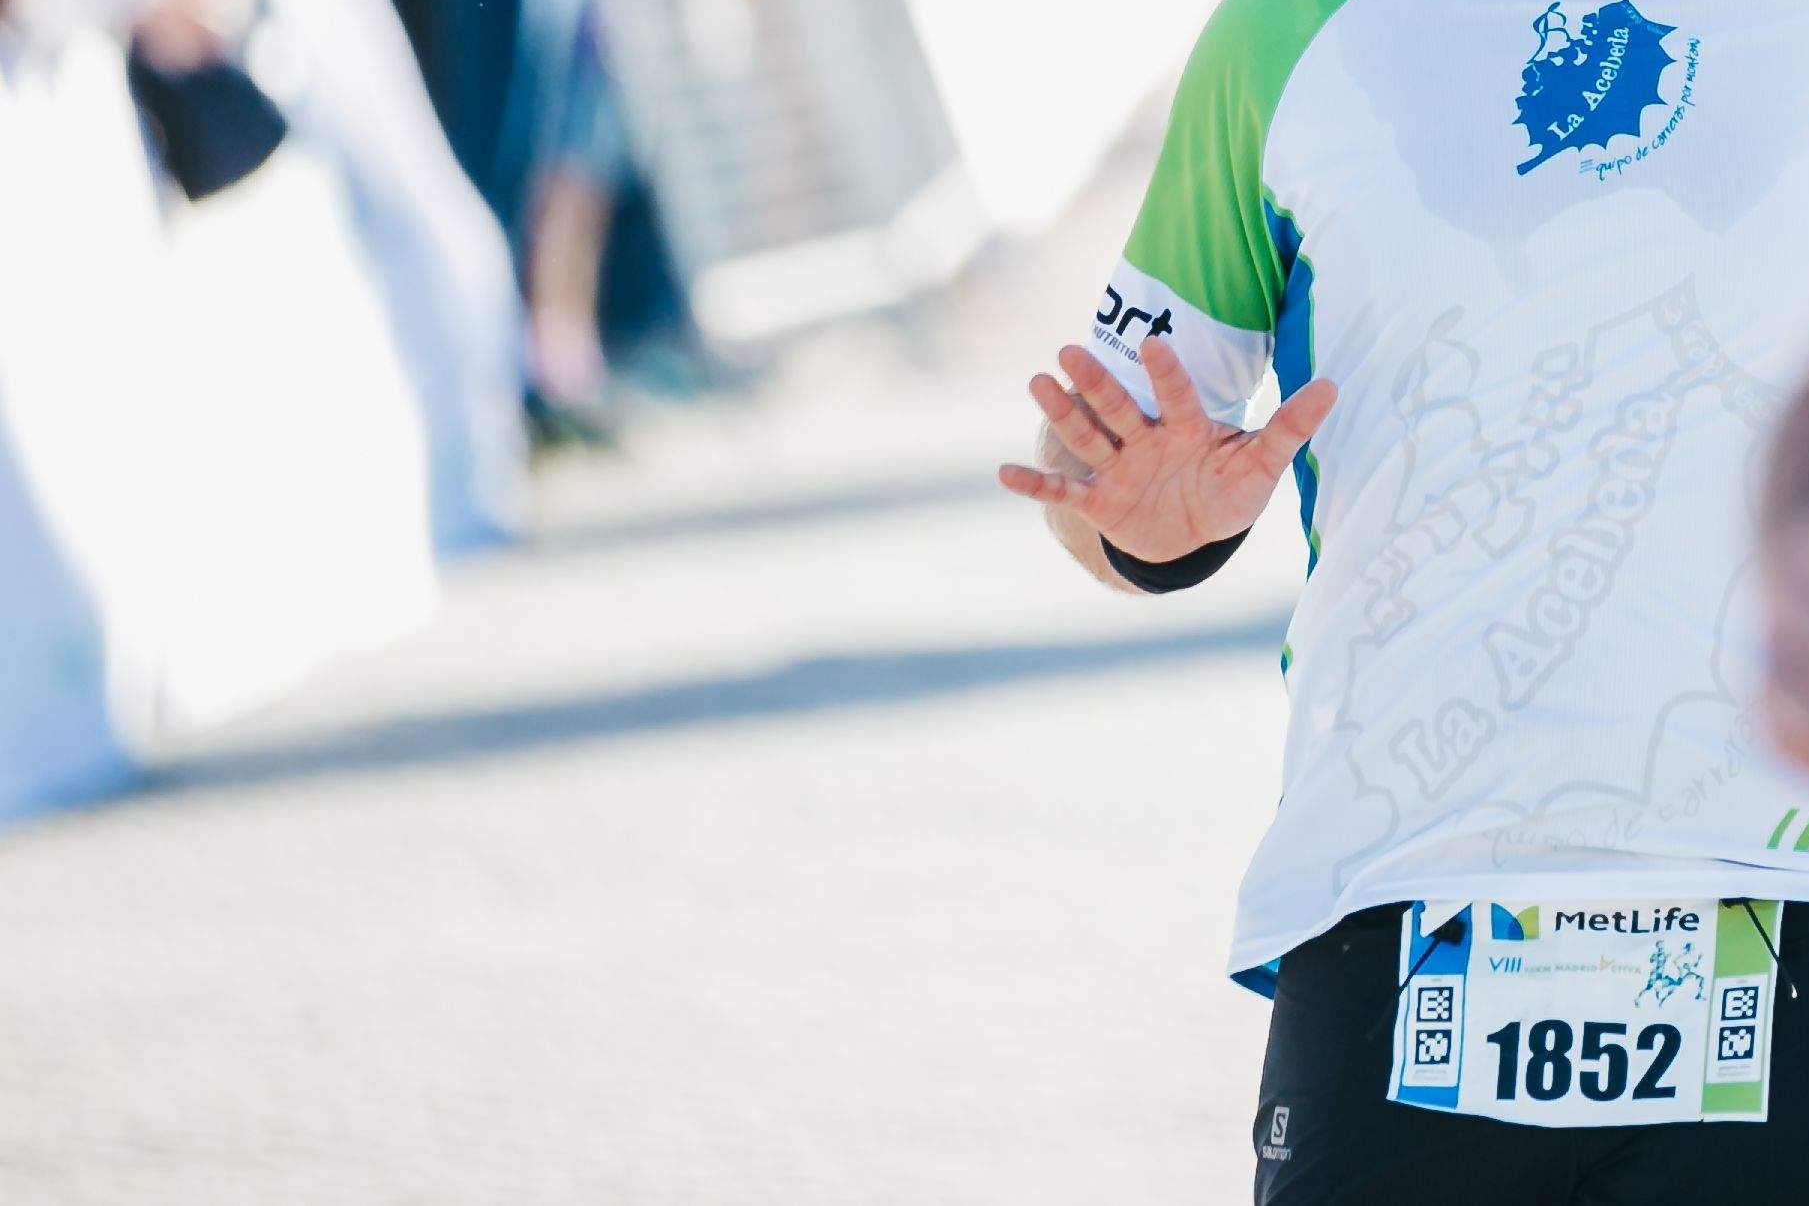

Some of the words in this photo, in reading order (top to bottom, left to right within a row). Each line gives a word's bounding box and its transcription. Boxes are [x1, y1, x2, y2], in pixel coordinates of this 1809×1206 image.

[1546, 112, 1584, 142] La
[1581, 26, 1630, 111] Acebeda
[1391, 698, 1497, 801] La
[1483, 391, 1683, 711] Acebeda
[1554, 906, 1700, 934] MetLife
[1488, 956, 1522, 974] VIII
[1486, 1019, 1682, 1102] 1852
